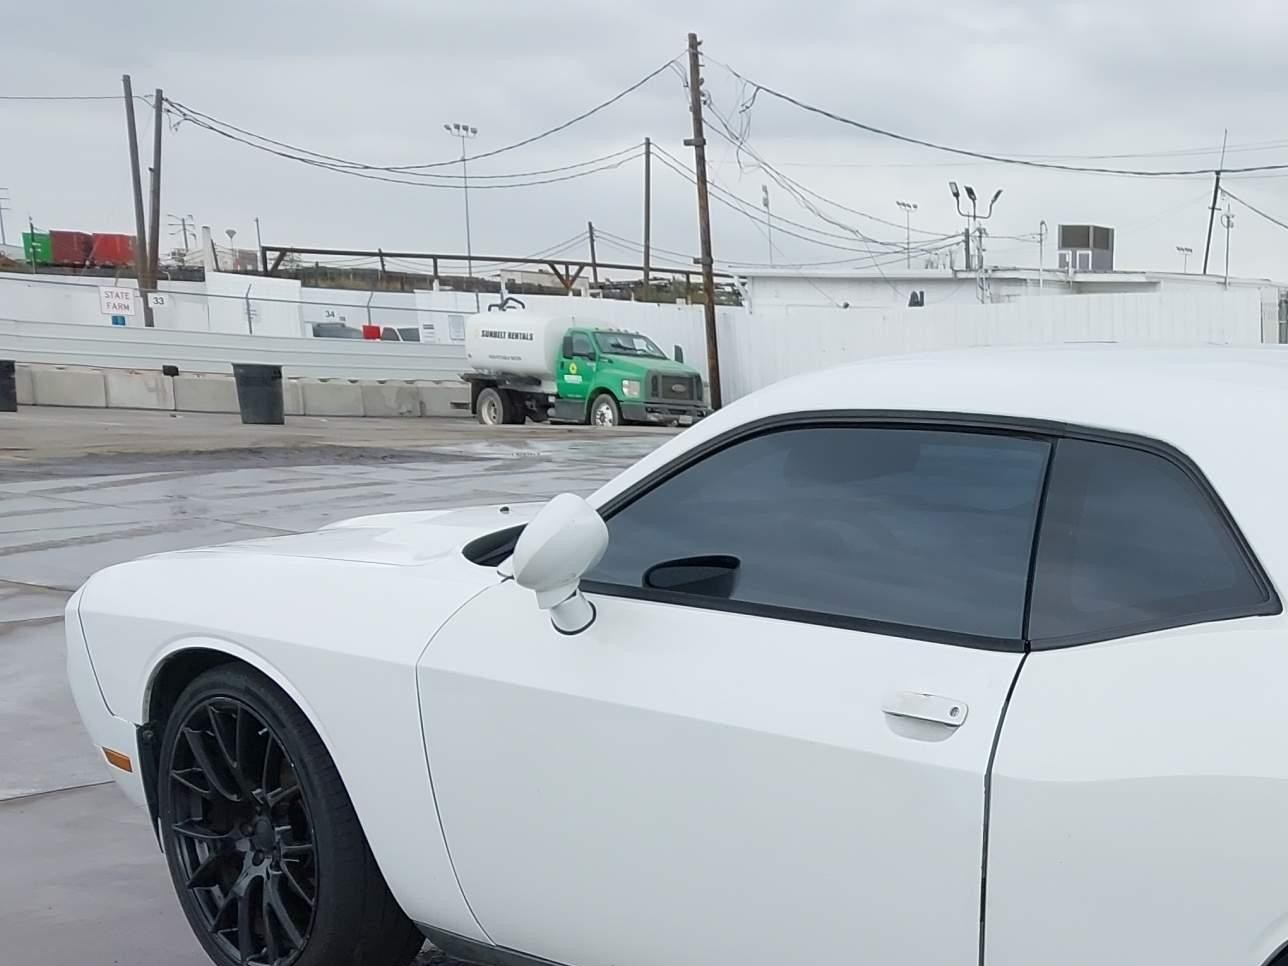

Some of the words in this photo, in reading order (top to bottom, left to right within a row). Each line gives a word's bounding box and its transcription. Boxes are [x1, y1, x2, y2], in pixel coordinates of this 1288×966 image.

[104, 290, 130, 300] STATE
[152, 296, 165, 305] 33
[106, 302, 130, 311] FARM
[481, 329, 506, 339] SUNBELT
[507, 331, 534, 341] RENTALS
